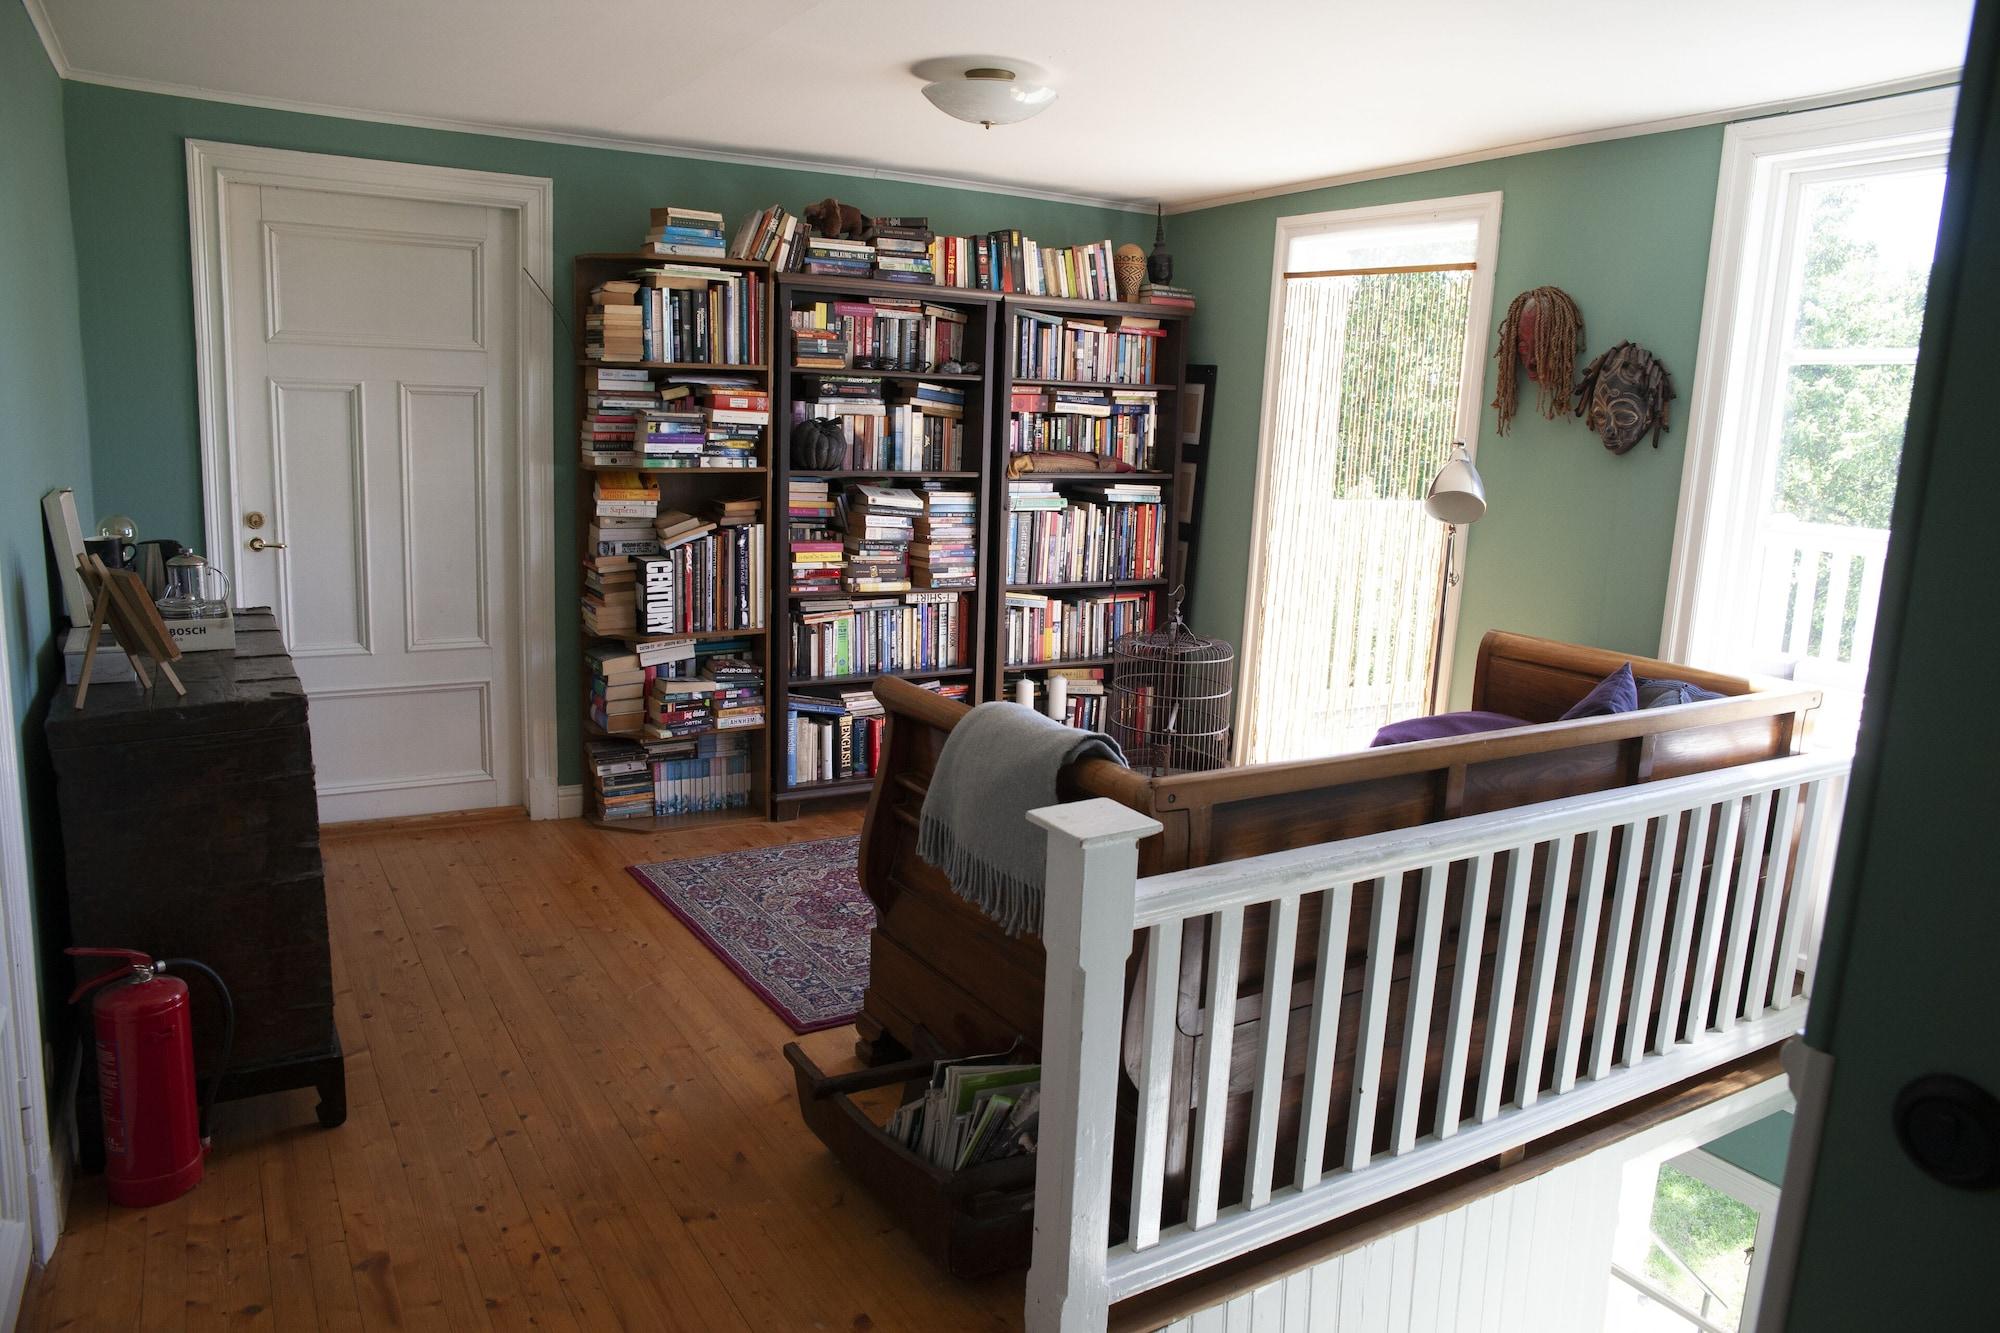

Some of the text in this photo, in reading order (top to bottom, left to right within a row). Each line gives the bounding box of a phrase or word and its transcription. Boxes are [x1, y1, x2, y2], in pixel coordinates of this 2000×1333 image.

[829, 251, 852, 259] WALKING
[948, 255, 956, 275] 1968
[610, 506, 637, 515] Sapiens
[646, 561, 674, 634] CENTURY
[914, 594, 950, 603] T-SHIRT
[169, 626, 207, 636] BOSCH
[841, 726, 851, 768] ENGLISH
